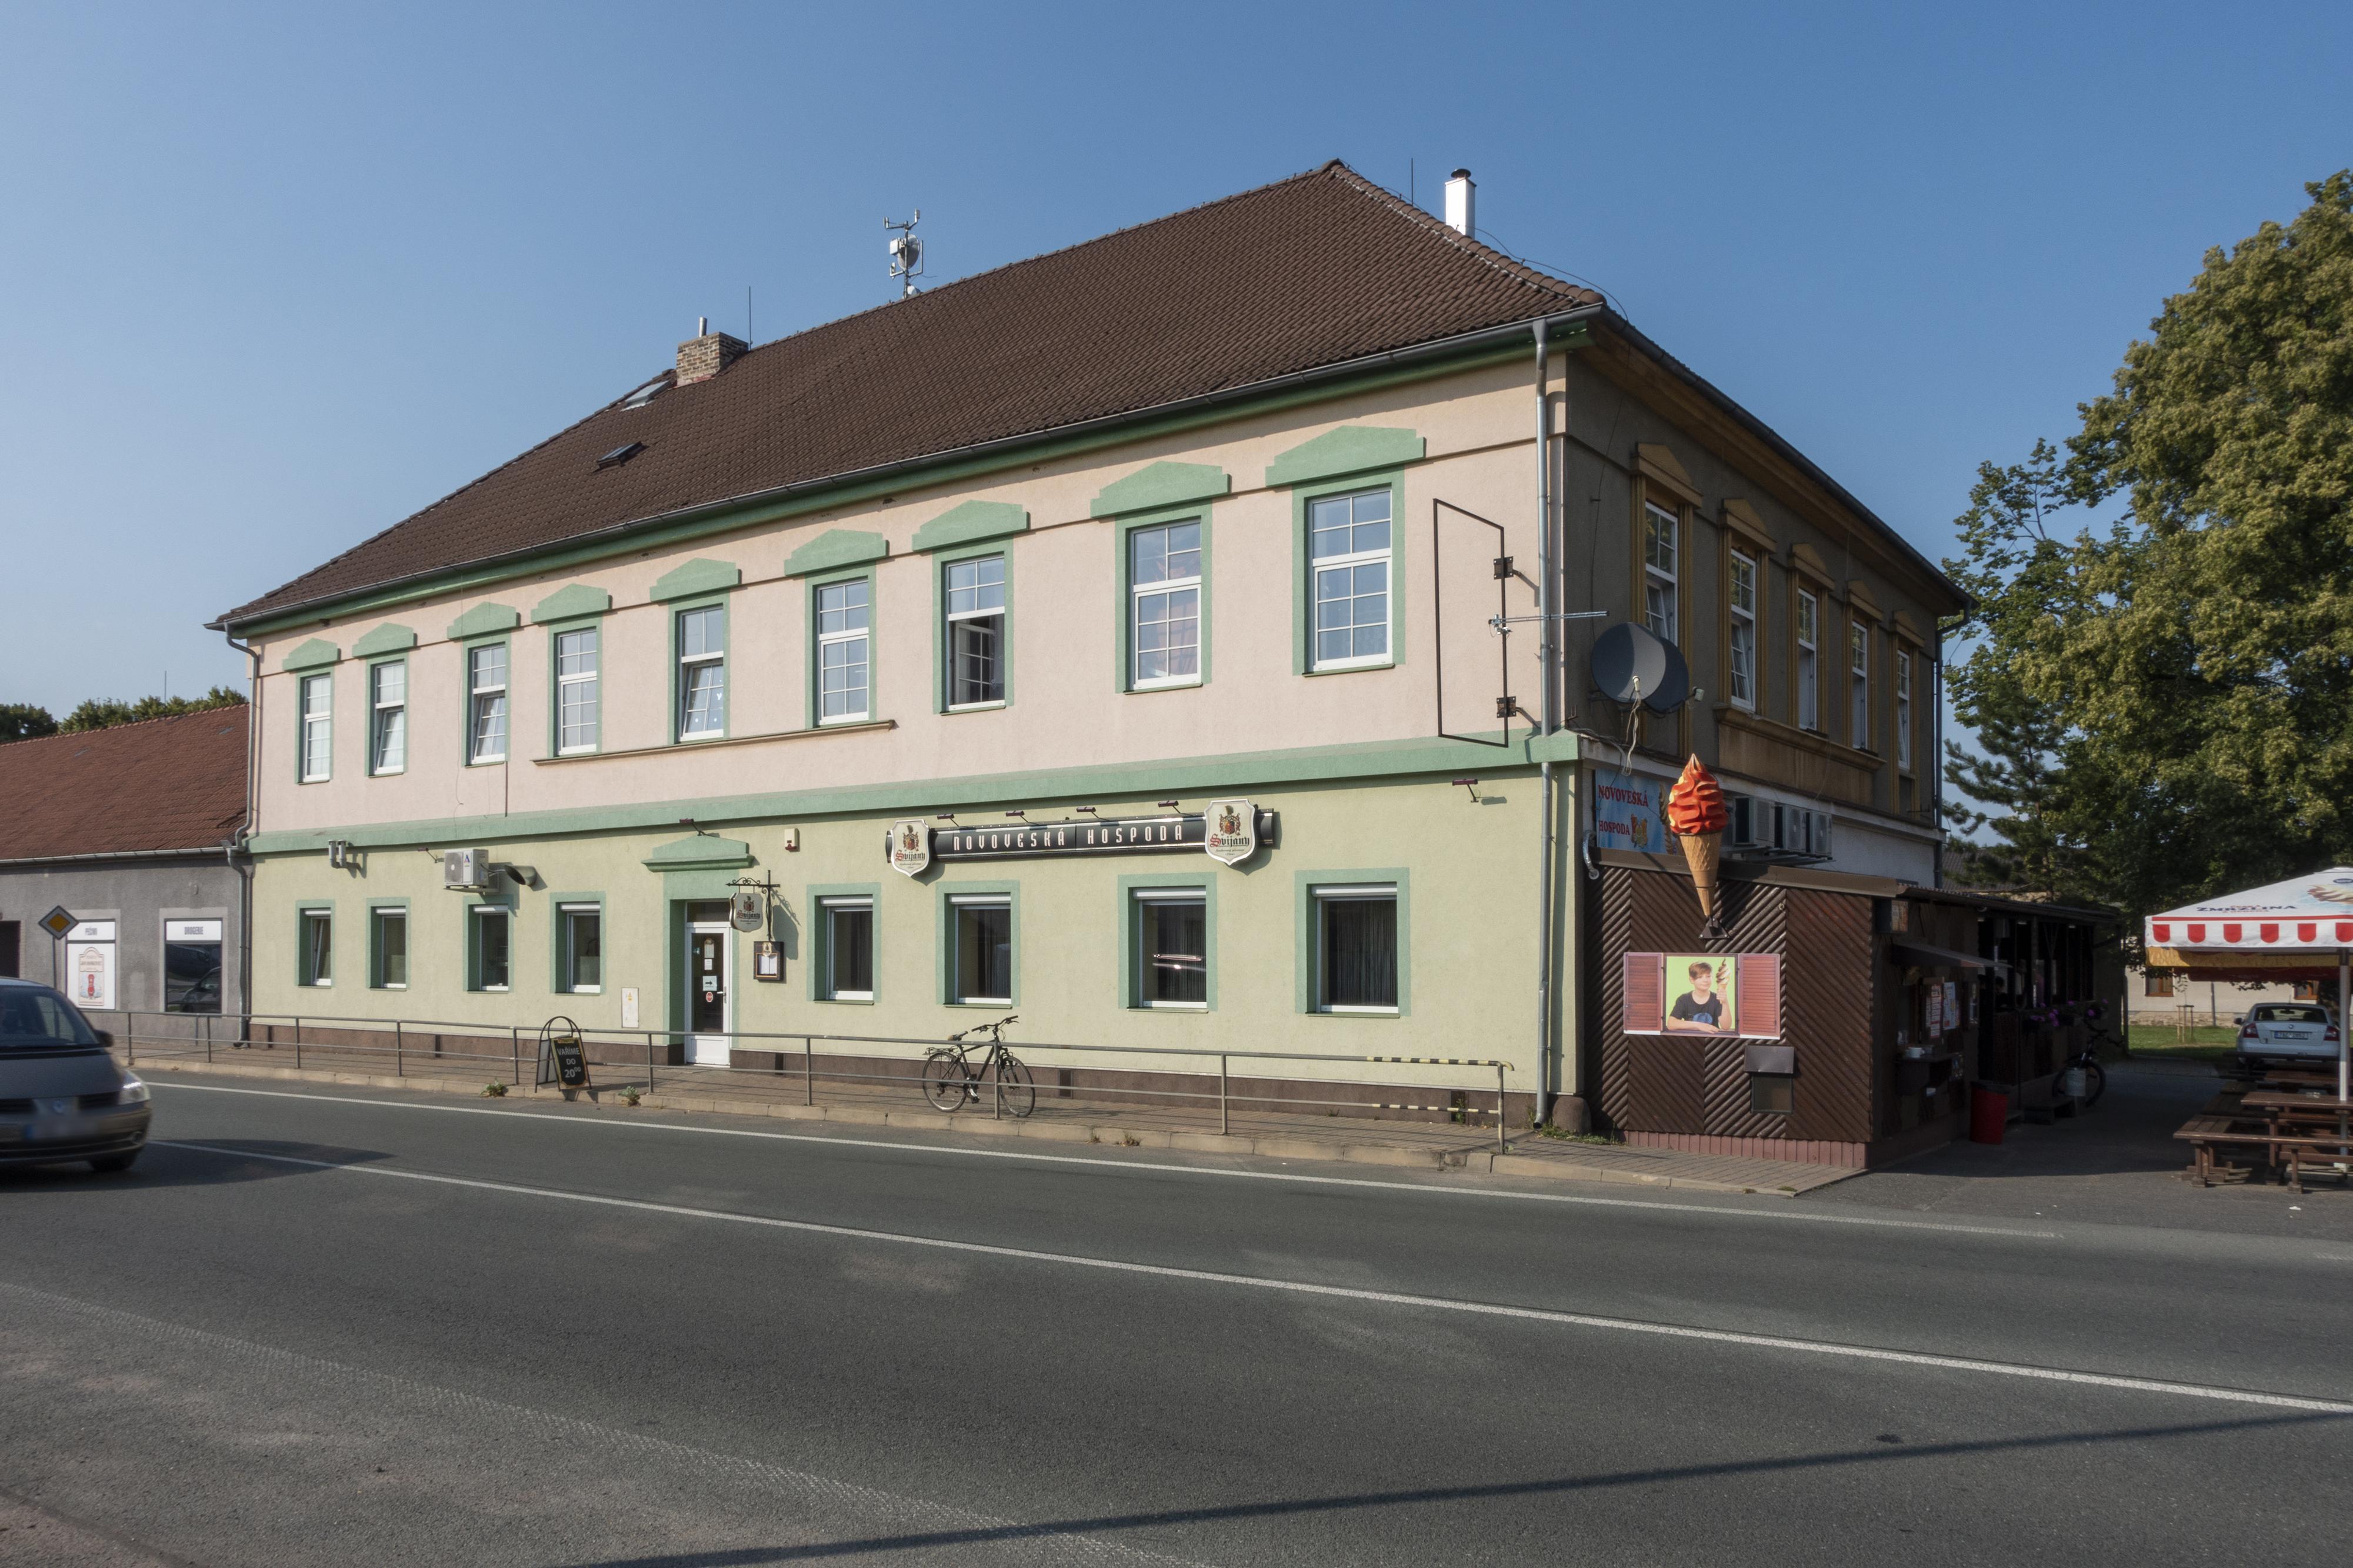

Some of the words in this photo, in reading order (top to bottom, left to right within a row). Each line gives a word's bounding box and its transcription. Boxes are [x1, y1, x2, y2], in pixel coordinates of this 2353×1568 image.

[1598, 785, 1649, 807] NOVOVESKÁ
[1598, 819, 1631, 835] HOSPODA
[953, 828, 1065, 851] NOVOVESKÁ
[1087, 825, 1182, 844] HOSPODA
[1209, 833, 1250, 848] Svijany
[895, 849, 926, 862] Svijany
[736, 909, 761, 920] Svijany
[556, 1047, 581, 1056] VAŘÍME
